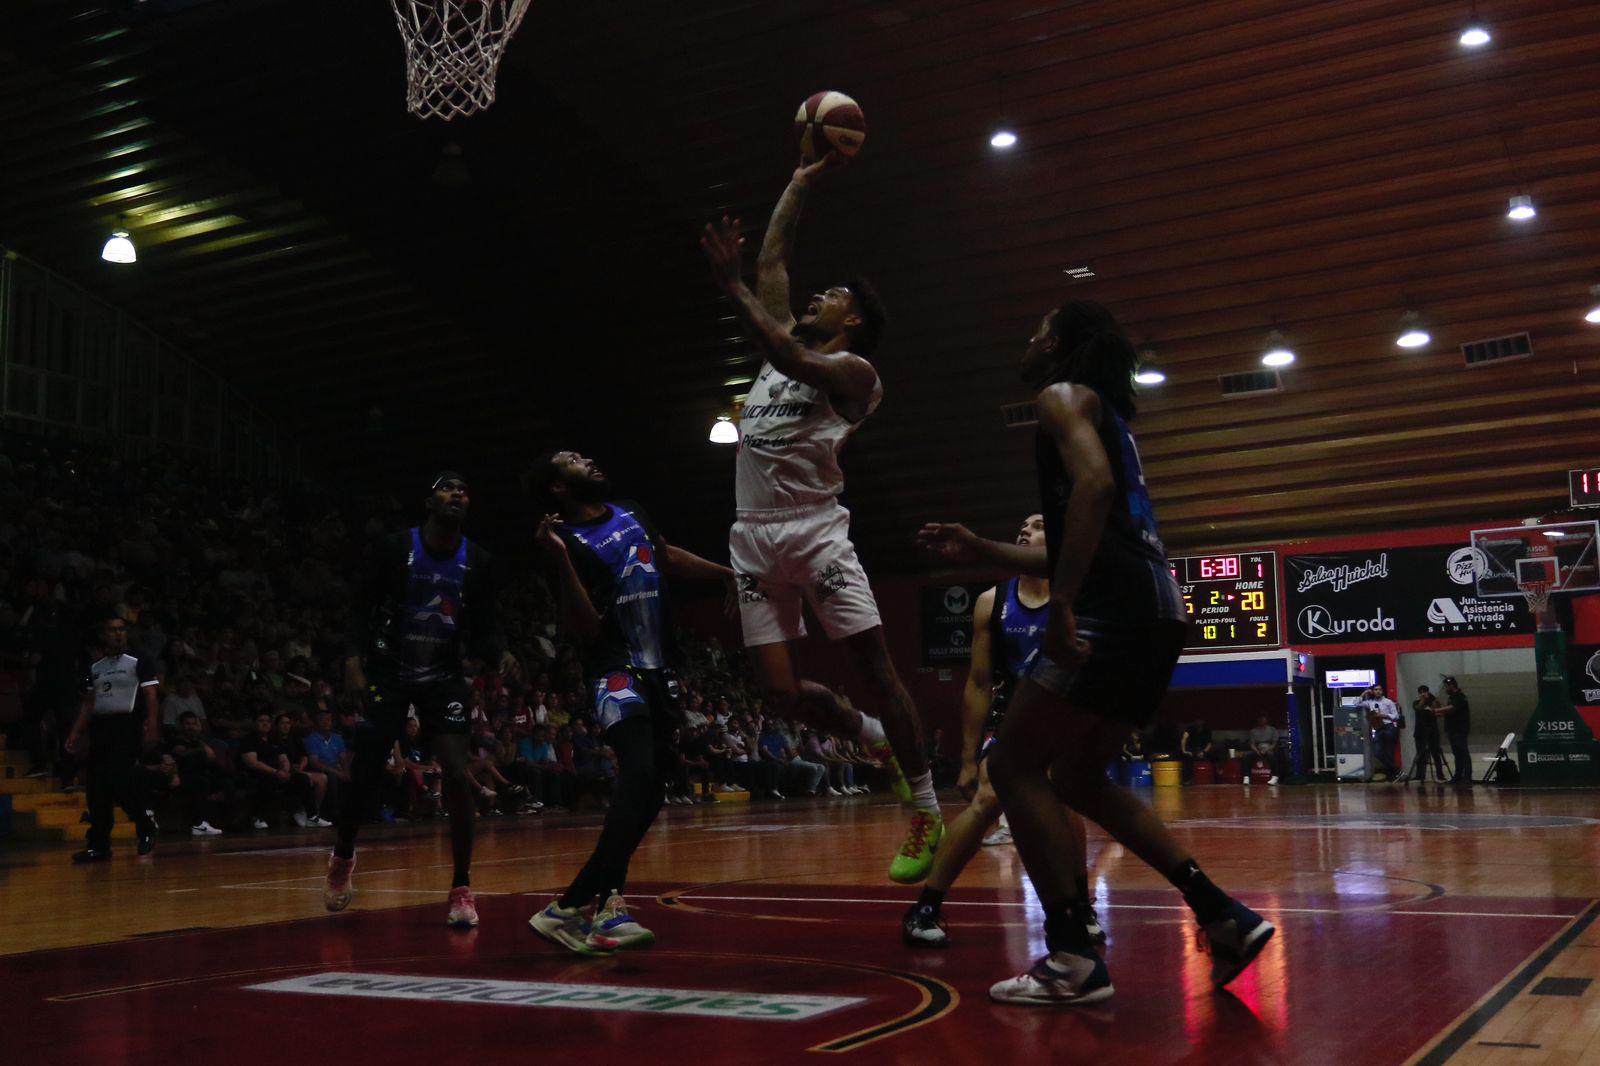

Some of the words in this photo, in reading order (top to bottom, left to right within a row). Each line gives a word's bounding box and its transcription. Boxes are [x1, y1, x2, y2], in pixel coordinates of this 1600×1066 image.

[1201, 558, 1238, 578] 6:38
[1257, 564, 1263, 577] 1
[1297, 566, 1335, 592] Salsa
[1331, 553, 1387, 592] Huichol
[1454, 562, 1474, 574] Pizz
[1235, 581, 1264, 590] HOME
[1210, 591, 1220, 605] 2
[1241, 591, 1265, 611] 20
[1462, 603, 1514, 614] Asistencia
[1301, 606, 1395, 637] Kuroda
[1467, 613, 1505, 622] Privada
[1203, 625, 1217, 640] 10
[1257, 623, 1267, 637] 2
[1428, 622, 1516, 633] SINALOA
